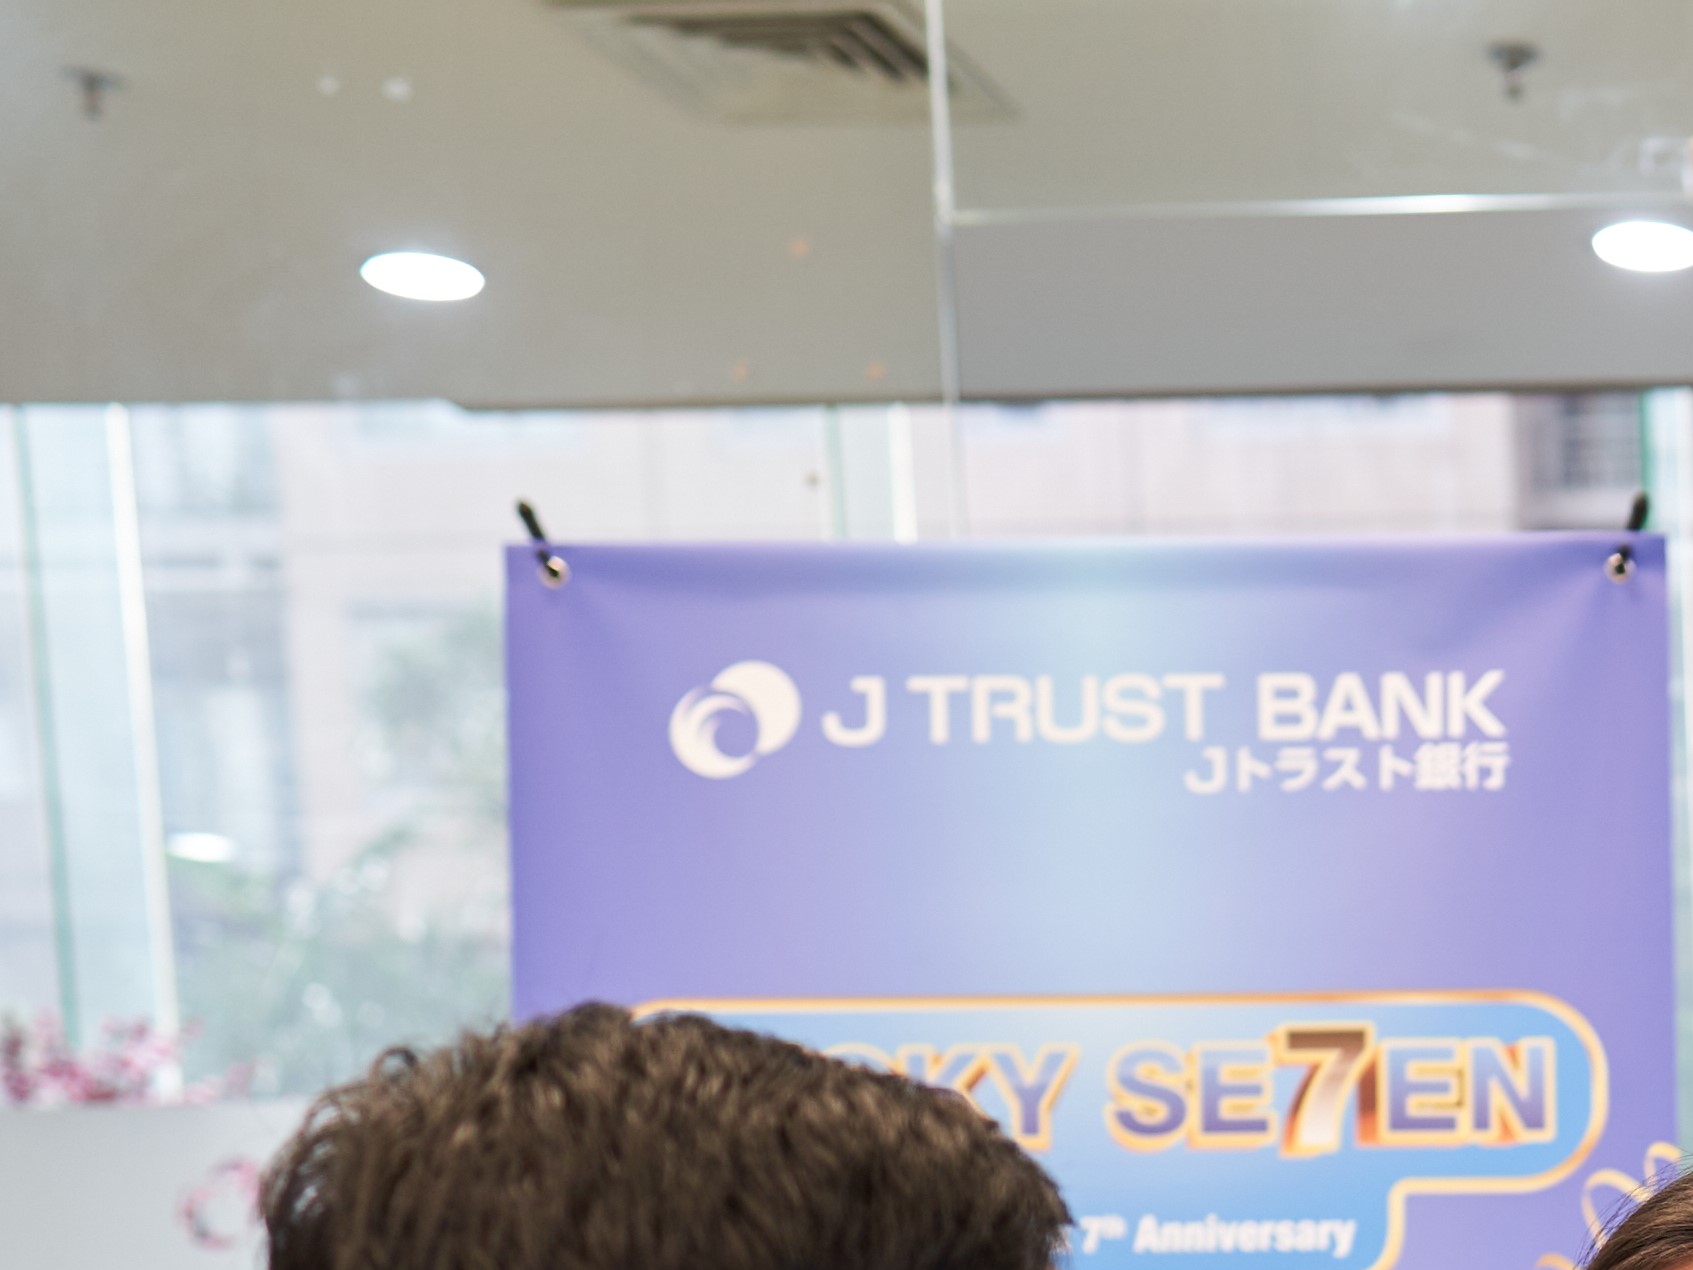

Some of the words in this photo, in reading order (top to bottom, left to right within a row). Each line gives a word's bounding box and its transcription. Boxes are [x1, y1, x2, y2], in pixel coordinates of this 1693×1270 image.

[822, 676, 887, 747] J
[907, 673, 1226, 745] TRUST
[1257, 669, 1505, 740] BANK
[1184, 742, 1509, 794] Jトラスト銀行
[824, 1042, 1079, 1153] KY
[1105, 1020, 1556, 1158] SE7EN
[1133, 1213, 1357, 1259] Anniversary
